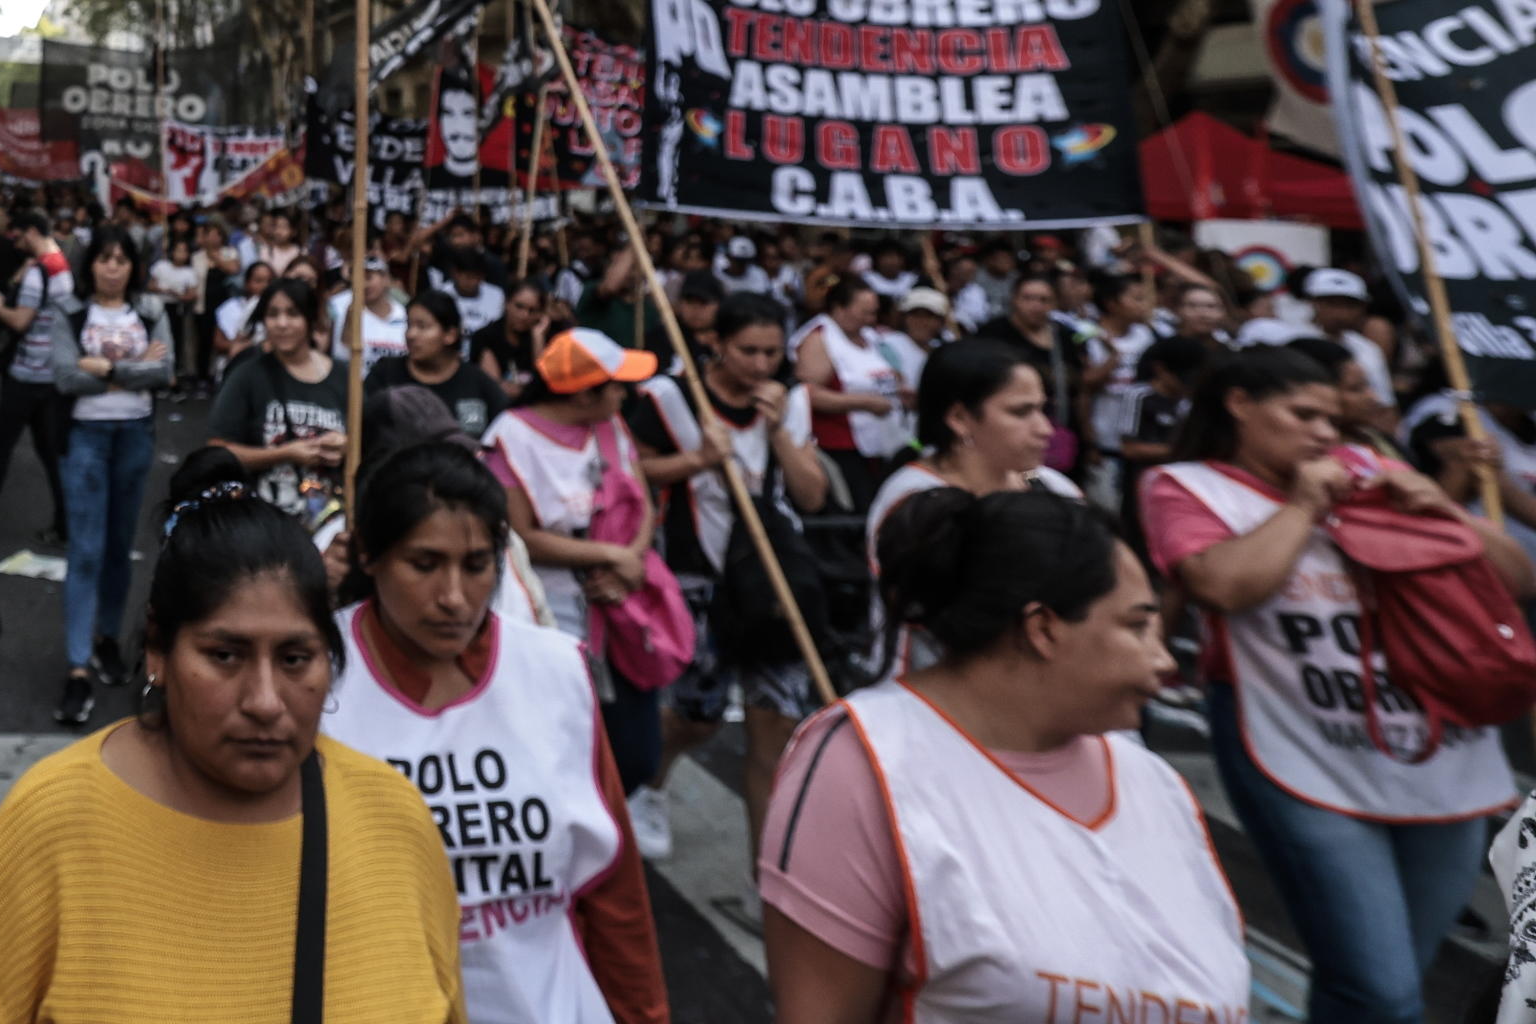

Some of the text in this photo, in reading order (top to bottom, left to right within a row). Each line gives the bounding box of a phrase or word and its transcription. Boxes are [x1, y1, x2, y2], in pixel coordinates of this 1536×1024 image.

[724, 7, 1071, 75] TENDENCIA
[729, 61, 1070, 125] ASAMBLEA
[723, 109, 1052, 176] LUGANO
[770, 166, 1025, 224] C.A.B.A.
